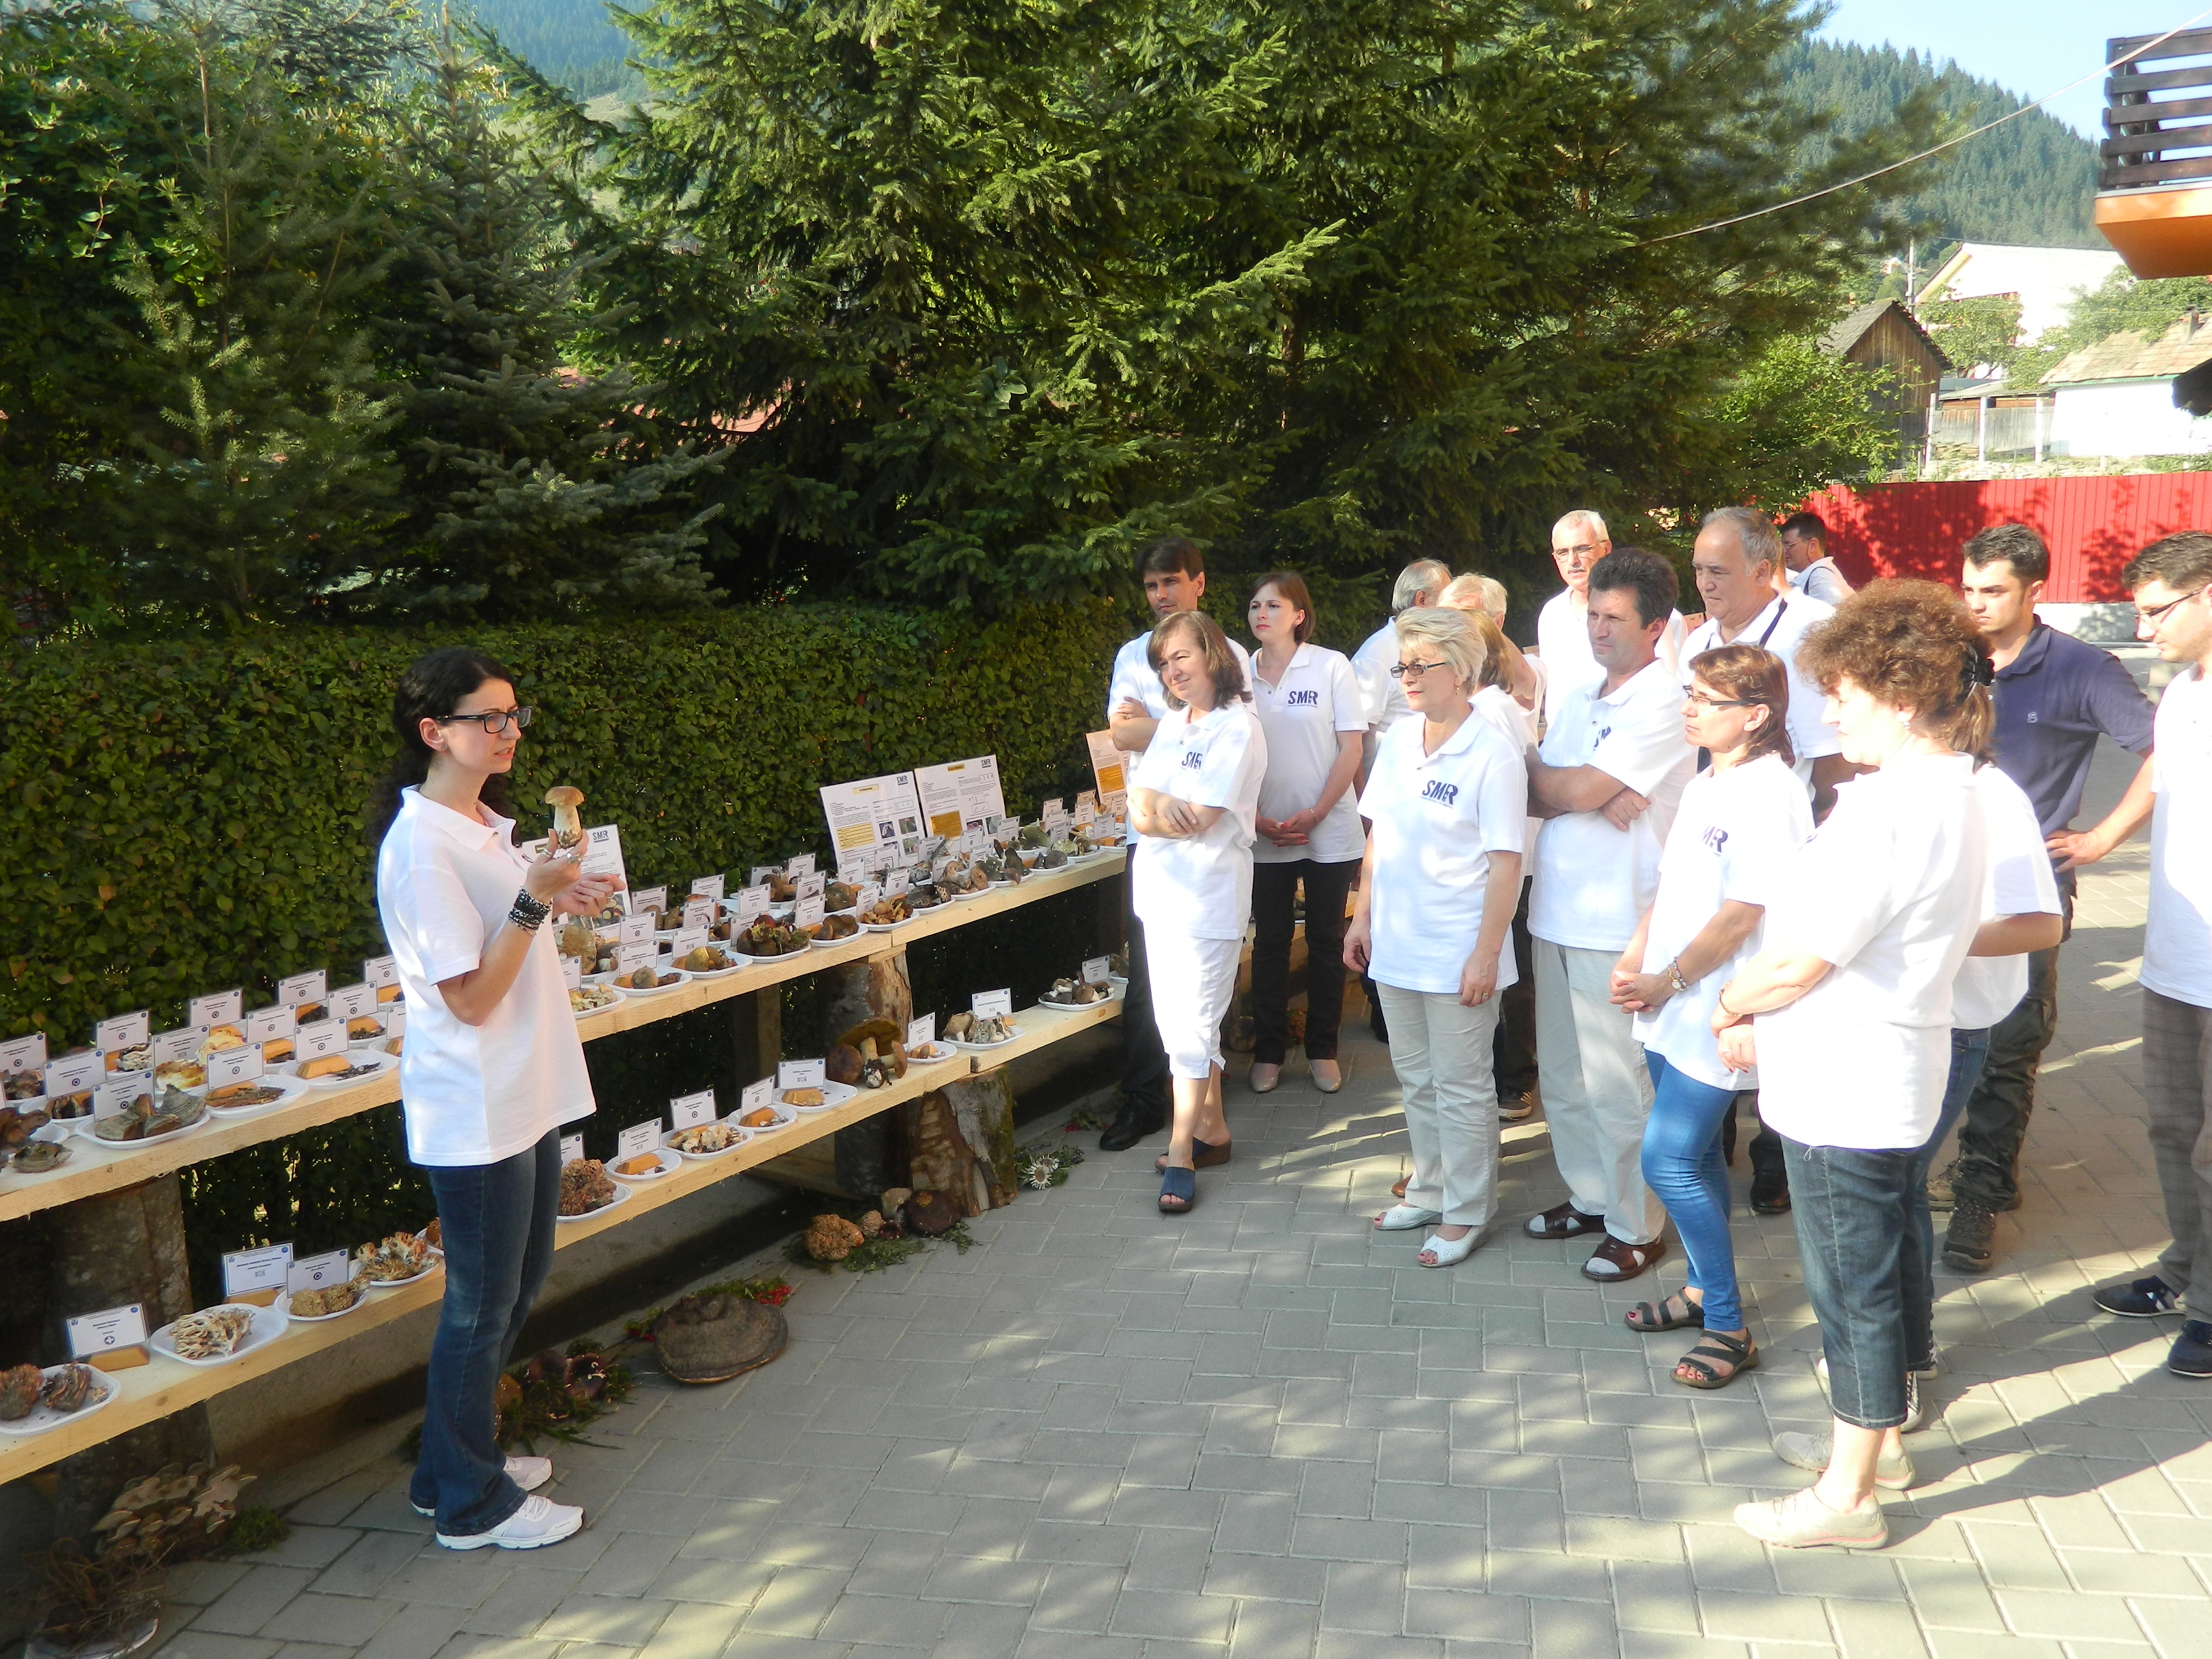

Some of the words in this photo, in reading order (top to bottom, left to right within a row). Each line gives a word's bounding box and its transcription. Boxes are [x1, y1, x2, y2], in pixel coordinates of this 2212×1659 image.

[1288, 690, 1318, 705] SMR
[1422, 780, 1458, 805] SMR
[593, 831, 609, 841] SMR
